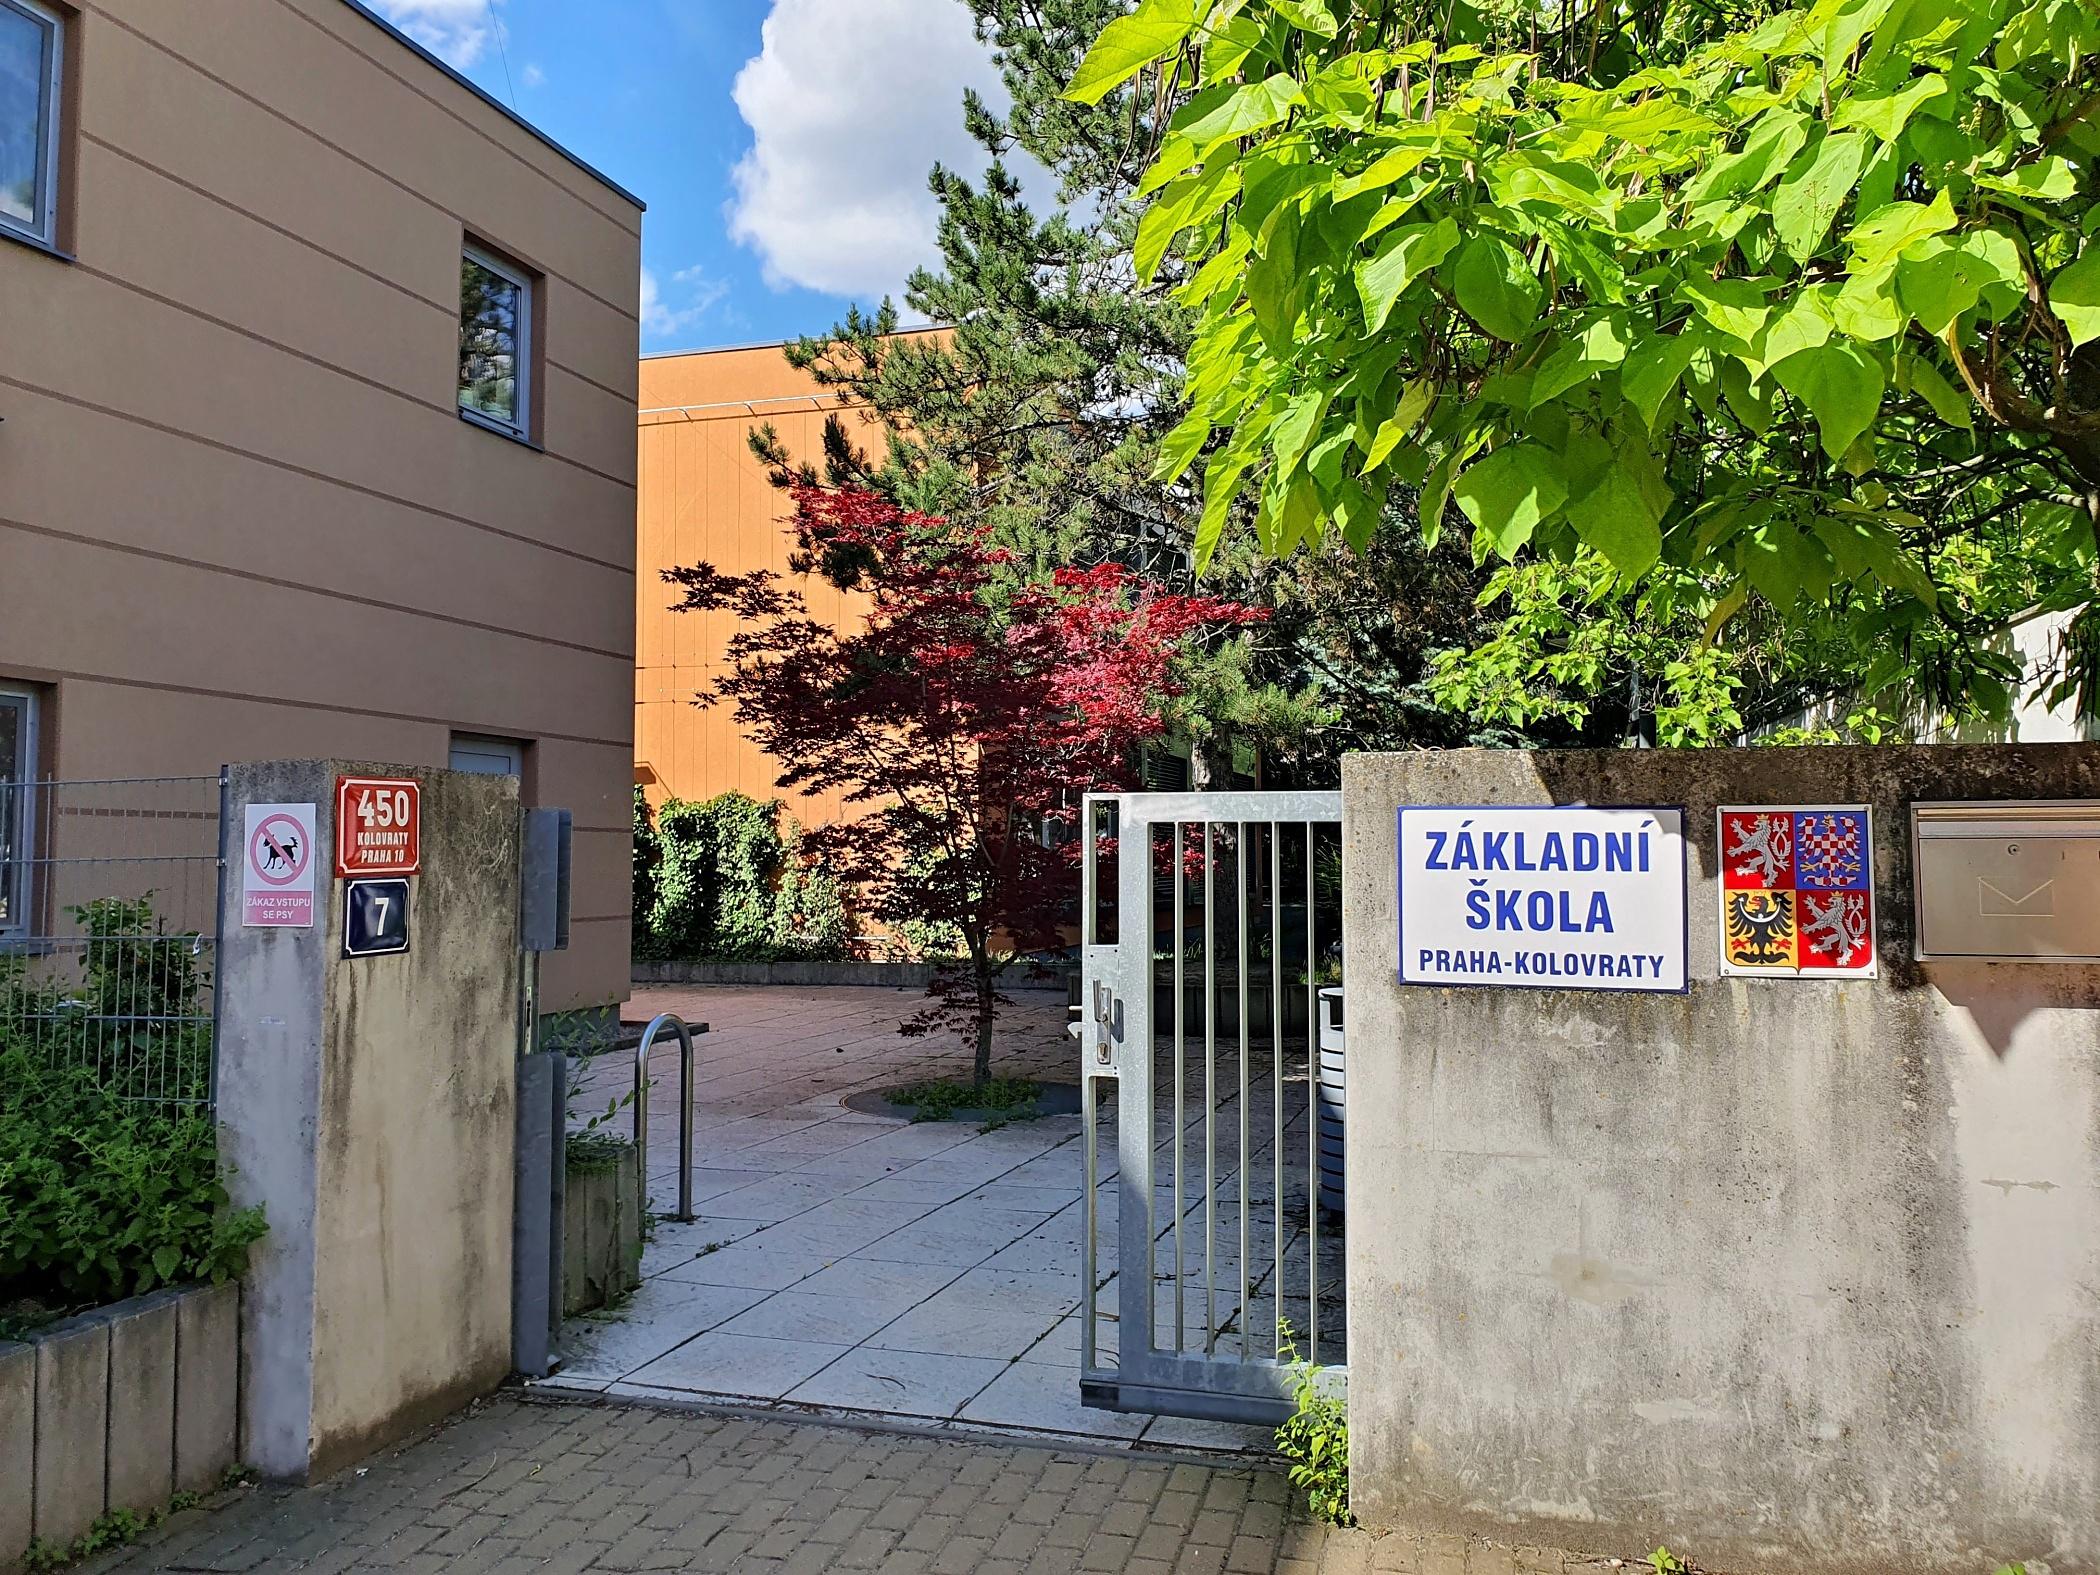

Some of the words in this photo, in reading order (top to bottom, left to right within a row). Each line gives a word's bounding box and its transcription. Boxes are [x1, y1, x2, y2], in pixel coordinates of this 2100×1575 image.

[358, 790, 409, 827] 450
[357, 832, 409, 846] KOLOVRATY
[1425, 820, 1654, 872] ZÁKLADNÍ
[361, 849, 391, 863] PRAHA
[395, 850, 405, 862] 10
[246, 896, 275, 907] ZÁKAZ
[276, 897, 311, 907] VSTUPU
[263, 910, 275, 919] SE
[276, 910, 294, 919] PSY
[1466, 879, 1615, 933] ŠKOLA
[374, 897, 390, 936] 7
[1419, 949, 1665, 978] PRAHA-KOLOVRATY
